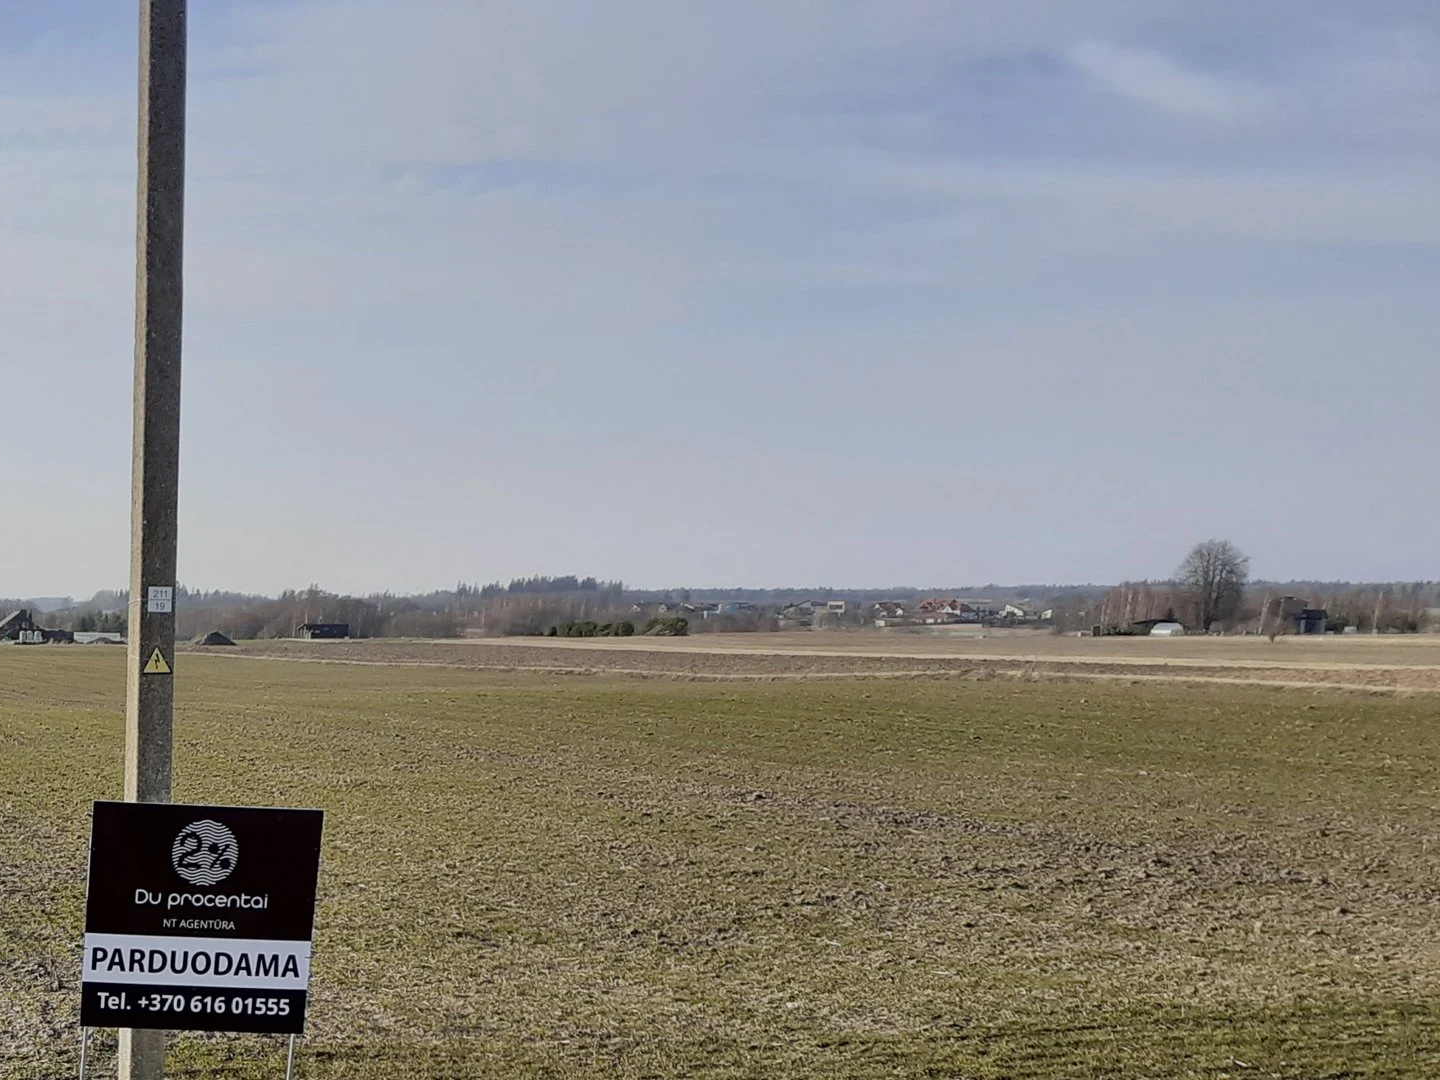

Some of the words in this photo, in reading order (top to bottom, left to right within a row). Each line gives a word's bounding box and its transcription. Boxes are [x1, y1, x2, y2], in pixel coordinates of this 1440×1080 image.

[153, 590, 168, 598] 211
[155, 602, 165, 610] 19
[134, 889, 162, 905] Du
[167, 892, 268, 910] procentai
[163, 918, 177, 929] NT
[179, 918, 236, 930] AGENTŪRA
[91, 947, 300, 978] PARDUODAMA
[97, 992, 131, 1010] Tel.
[137, 994, 185, 1012] +370
[190, 995, 226, 1014] 616
[231, 997, 290, 1016] 01555
